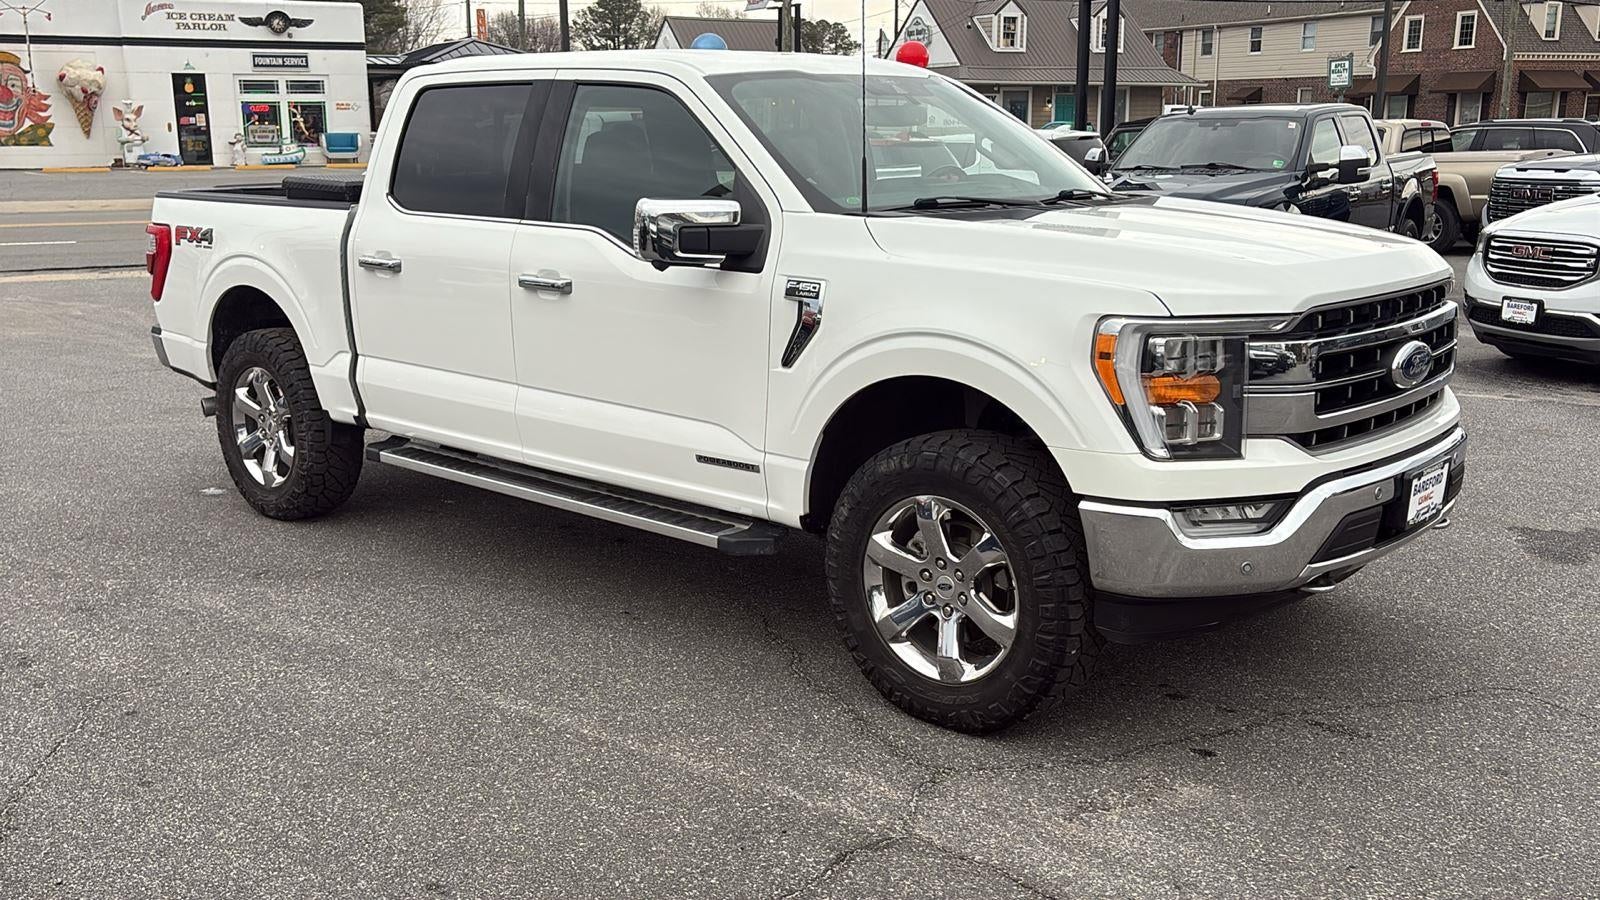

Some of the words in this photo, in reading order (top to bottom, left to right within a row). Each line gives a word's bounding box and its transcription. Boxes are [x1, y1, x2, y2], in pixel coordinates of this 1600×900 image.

[166, 12, 187, 20] ICE
[190, 13, 235, 22] CREAM
[176, 22, 227, 31] PARLOR
[254, 57, 283, 65] FOUNTAIN
[283, 57, 307, 66] SERVICE
[1513, 189, 1551, 200] GMC
[175, 225, 213, 246] FX4
[1511, 244, 1553, 260] GMC
[787, 281, 820, 292] F-150
[1506, 302, 1535, 312] BAREFORD
[1410, 352, 1429, 375] Ford
[1413, 472, 1444, 497] BAREFORD
[1418, 491, 1434, 505] GMC
